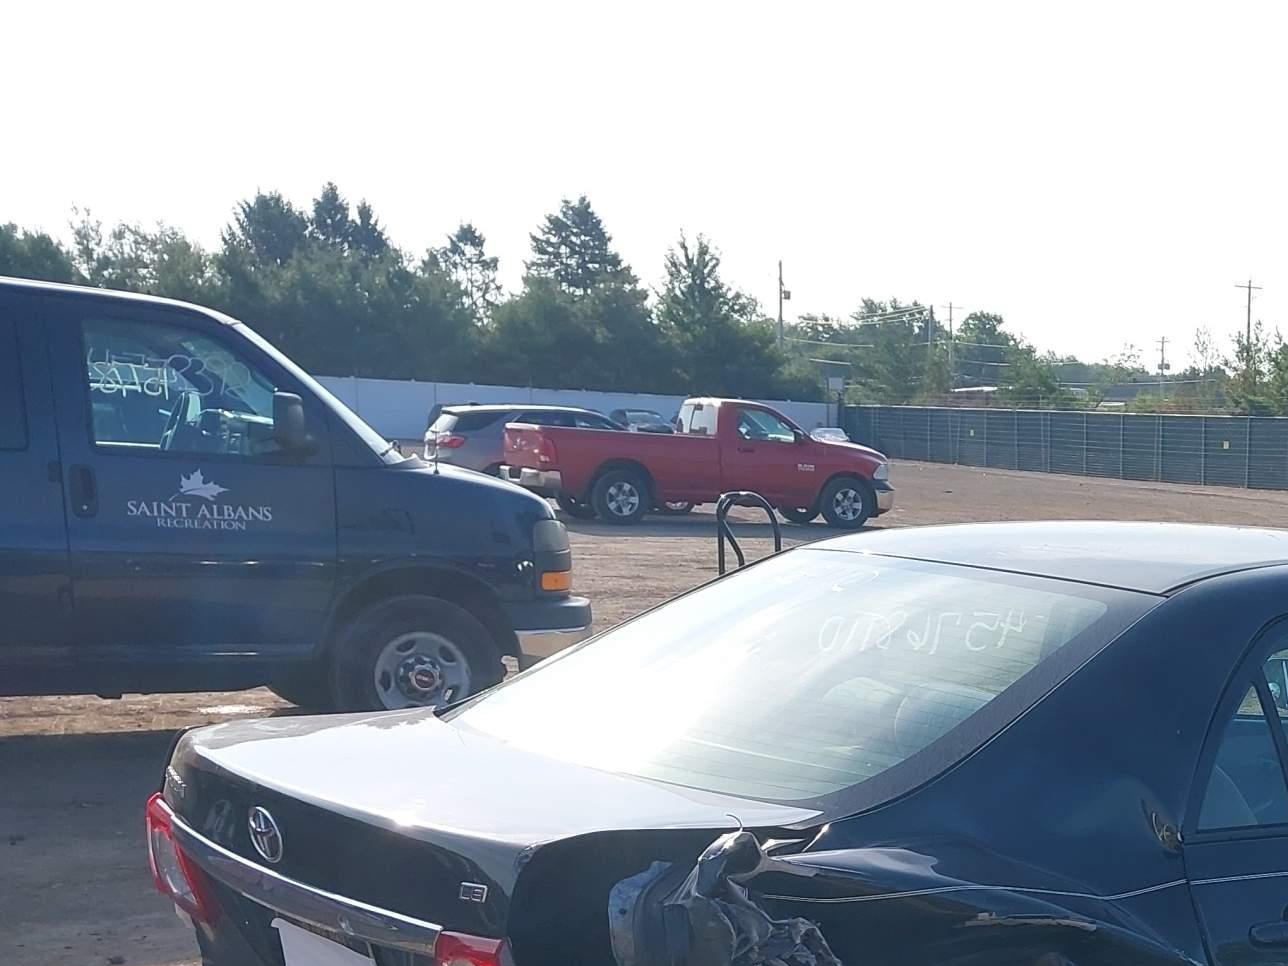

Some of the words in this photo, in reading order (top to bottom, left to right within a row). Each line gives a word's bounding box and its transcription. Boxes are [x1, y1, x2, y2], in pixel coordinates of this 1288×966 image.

[127, 500, 192, 518] SAINT
[197, 504, 273, 522] ALBANS
[157, 517, 246, 531] RECREATION
